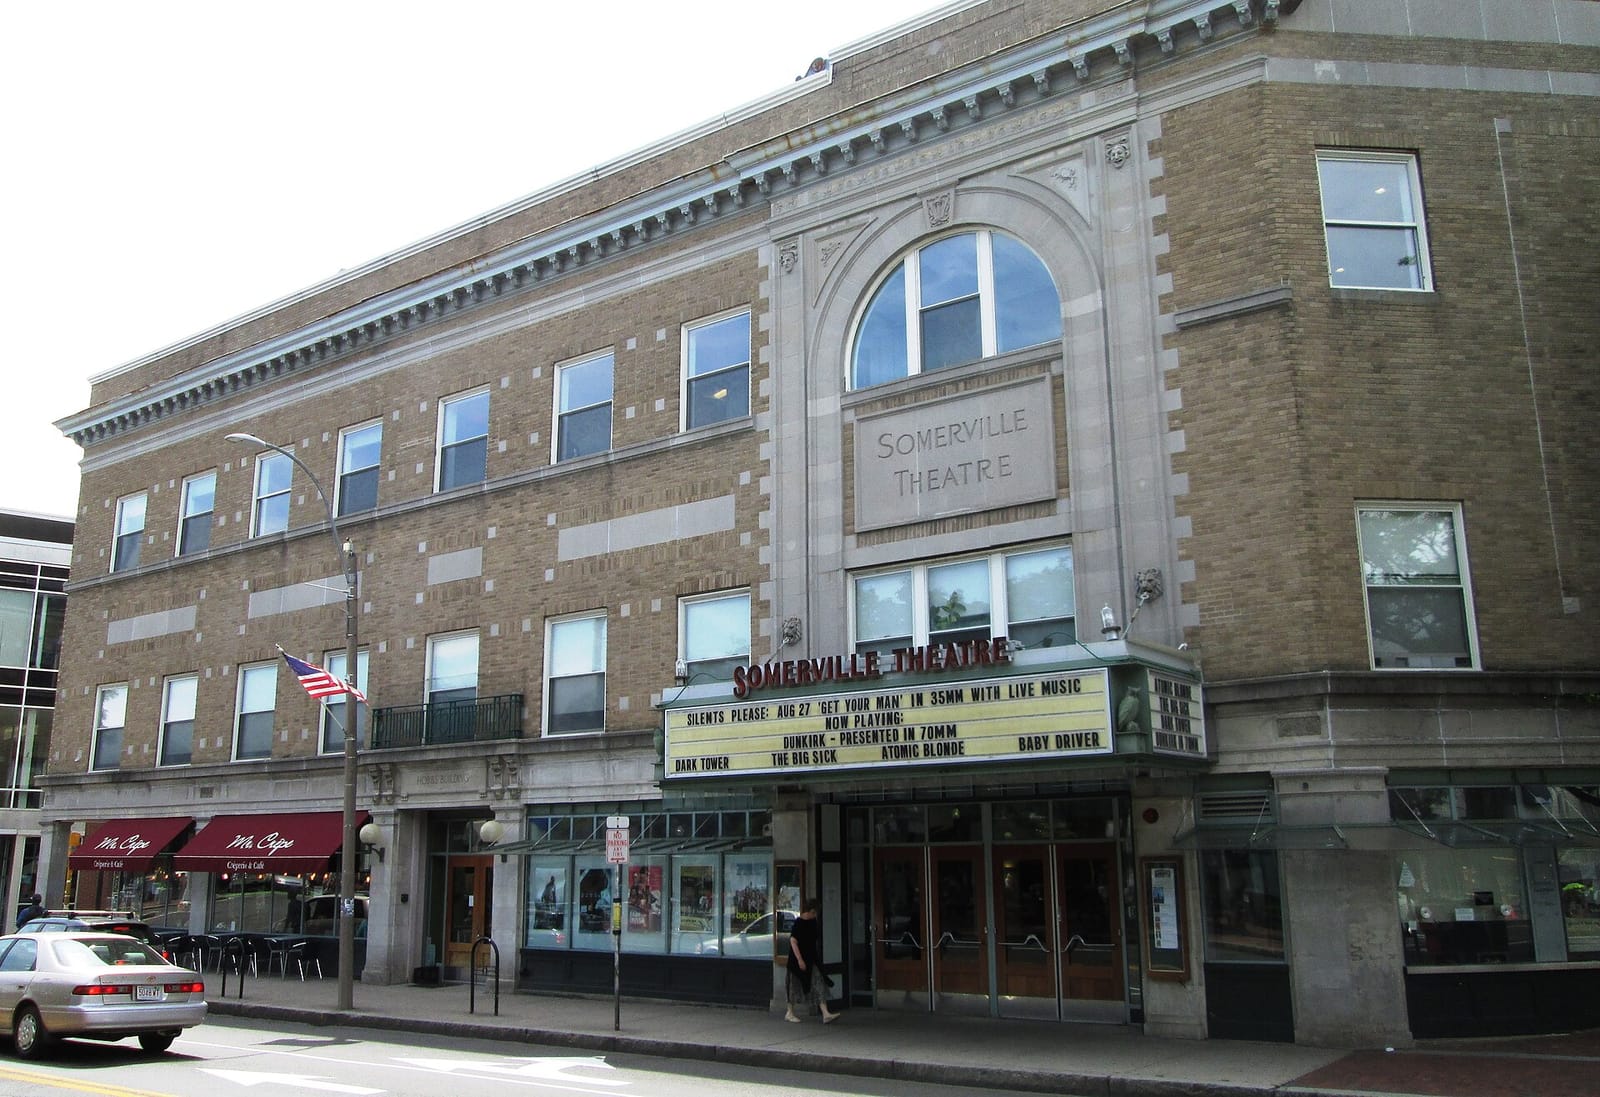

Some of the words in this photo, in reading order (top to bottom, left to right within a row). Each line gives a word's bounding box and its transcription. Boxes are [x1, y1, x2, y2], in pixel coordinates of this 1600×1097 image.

[878, 409, 1028, 458] SOMERVILLE
[894, 454, 1013, 497] THEATRE
[733, 651, 881, 698] SOMERVILLE
[892, 637, 1011, 672] THEATRE
[687, 711, 724, 726] SILENTS
[731, 706, 769, 722] PLEASE:
[777, 704, 795, 718] AUG
[798, 702, 811, 717] 27
[818, 700, 840, 715] 'GET
[845, 697, 870, 712] YOUR
[876, 694, 903, 710] MAN'
[911, 693, 923, 707] IN
[930, 689, 964, 705] 35MM
[971, 685, 1000, 701] WITH
[1008, 682, 1035, 698] LIVE
[1041, 678, 1081, 695] MUSIC
[825, 715, 849, 730] NOW
[854, 711, 903, 728] PLAYING:
[783, 733, 825, 749] DUNKIRK
[840, 728, 899, 745] PRESENTED
[903, 727, 915, 741] IN
[920, 724, 957, 740] 70MM
[1018, 735, 1049, 751] BABY
[1055, 732, 1099, 748] DRIVER
[771, 752, 789, 767] THE
[792, 751, 809, 766] BIG
[812, 749, 837, 764] SICK
[881, 744, 919, 759] ATOMIC
[923, 741, 965, 757] BLONDE
[675, 758, 697, 772] DARK
[700, 756, 729, 770] TOWER
